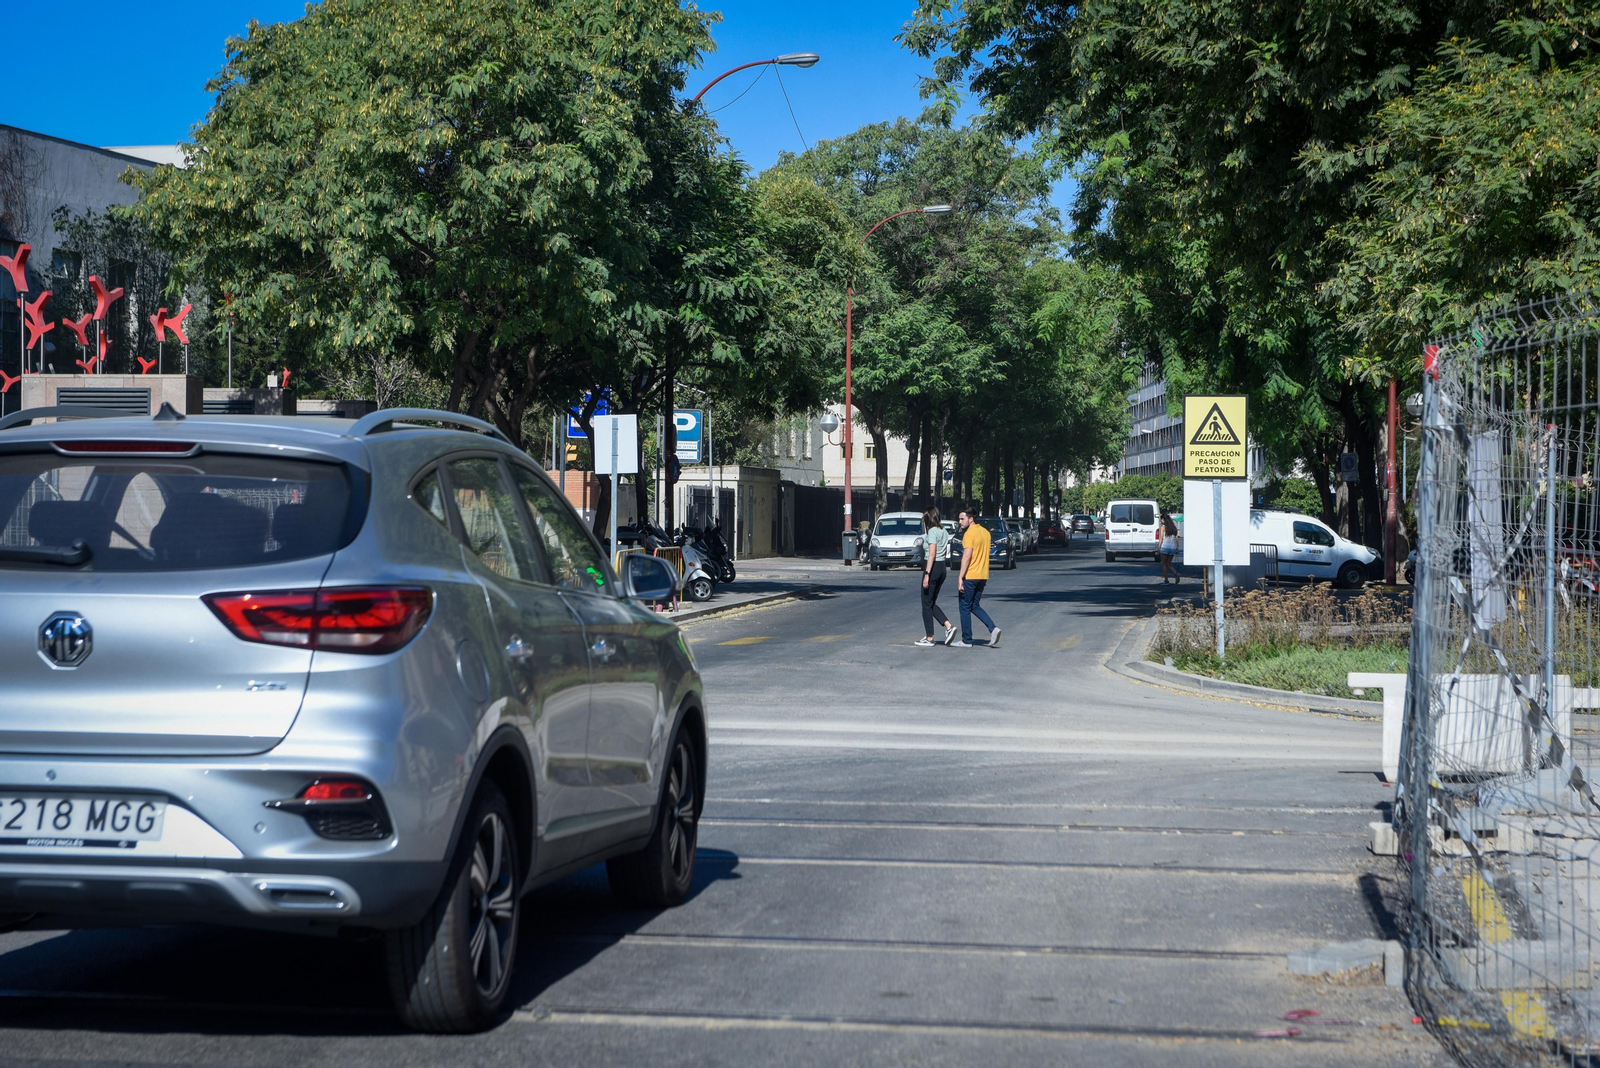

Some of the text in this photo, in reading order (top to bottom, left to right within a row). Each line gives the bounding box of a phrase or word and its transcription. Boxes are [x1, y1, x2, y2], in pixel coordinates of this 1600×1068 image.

[673, 413, 697, 433] P
[39, 616, 92, 663] MG
[0, 797, 157, 834] 218 MGG
[27, 838, 56, 846] MOTOR
